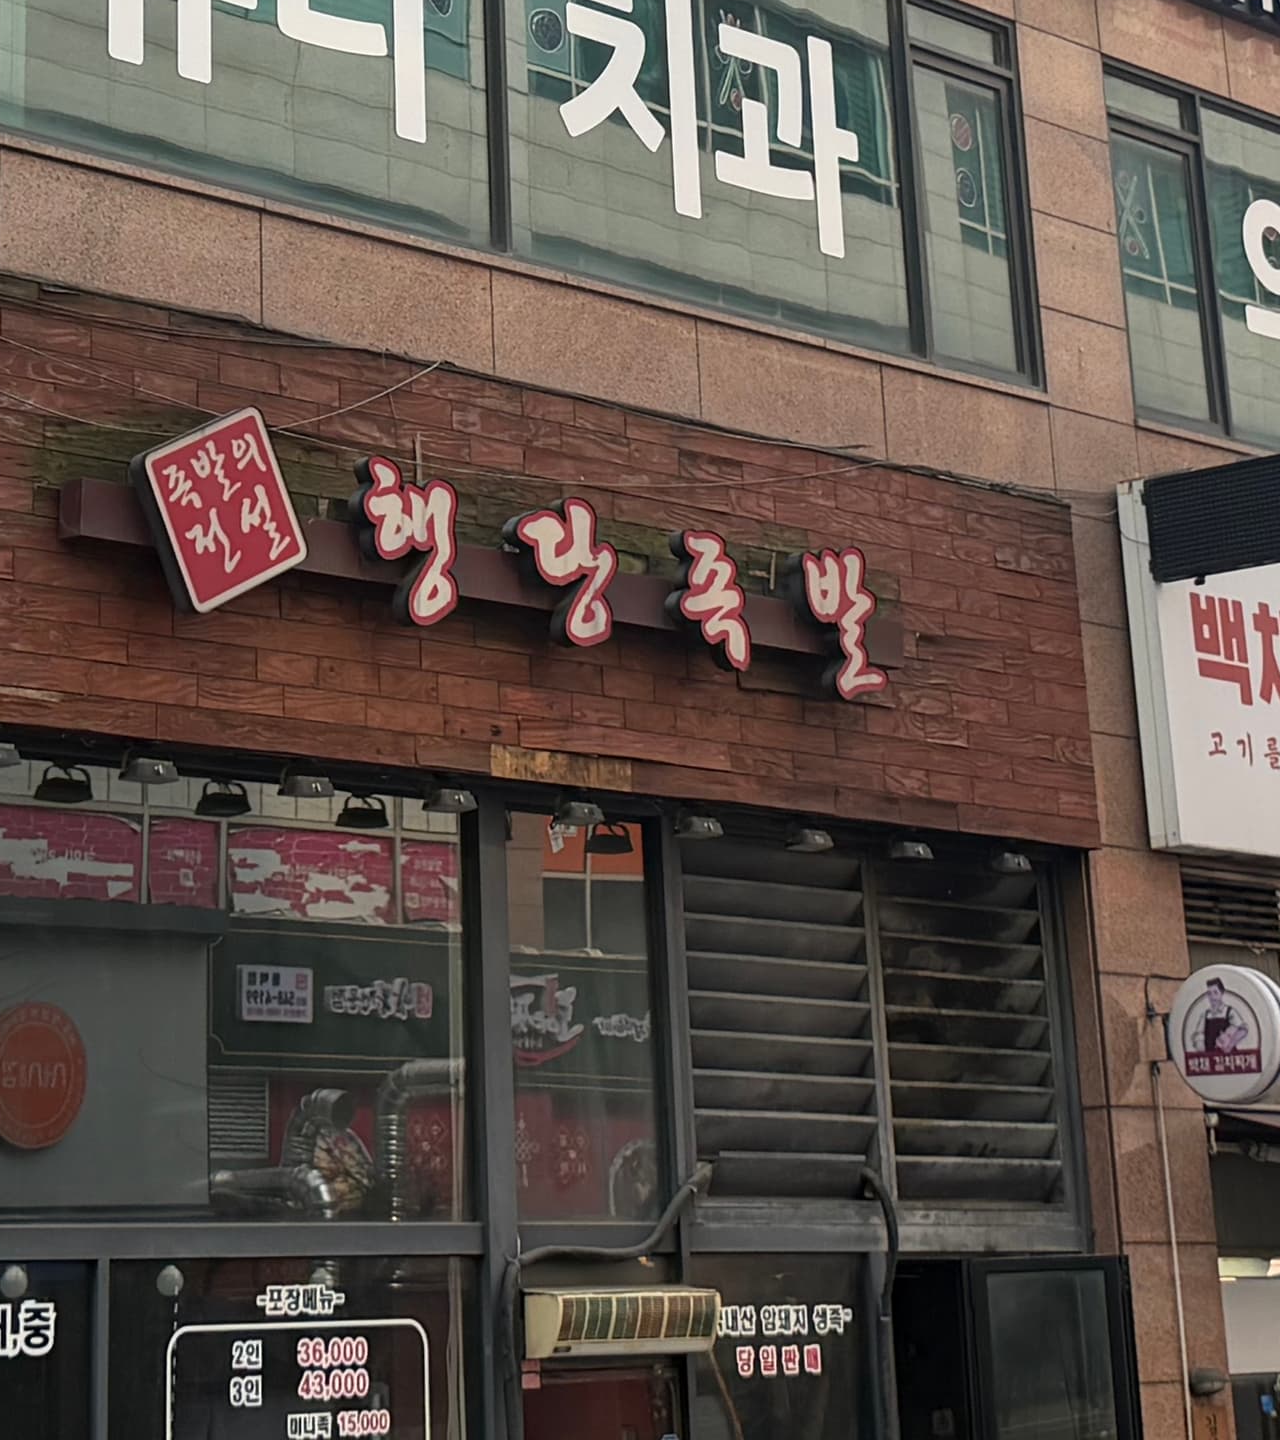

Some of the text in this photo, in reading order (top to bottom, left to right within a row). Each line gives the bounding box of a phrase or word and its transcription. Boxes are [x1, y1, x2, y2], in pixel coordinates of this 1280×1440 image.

[166, 429, 268, 510] 족발의
[183, 490, 293, 574] 전설
[232, 1336, 369, 1370] 2인 36,000
[229, 1369, 370, 1407] 3인 43,000
[336, 1409, 391, 1438] 15,000
